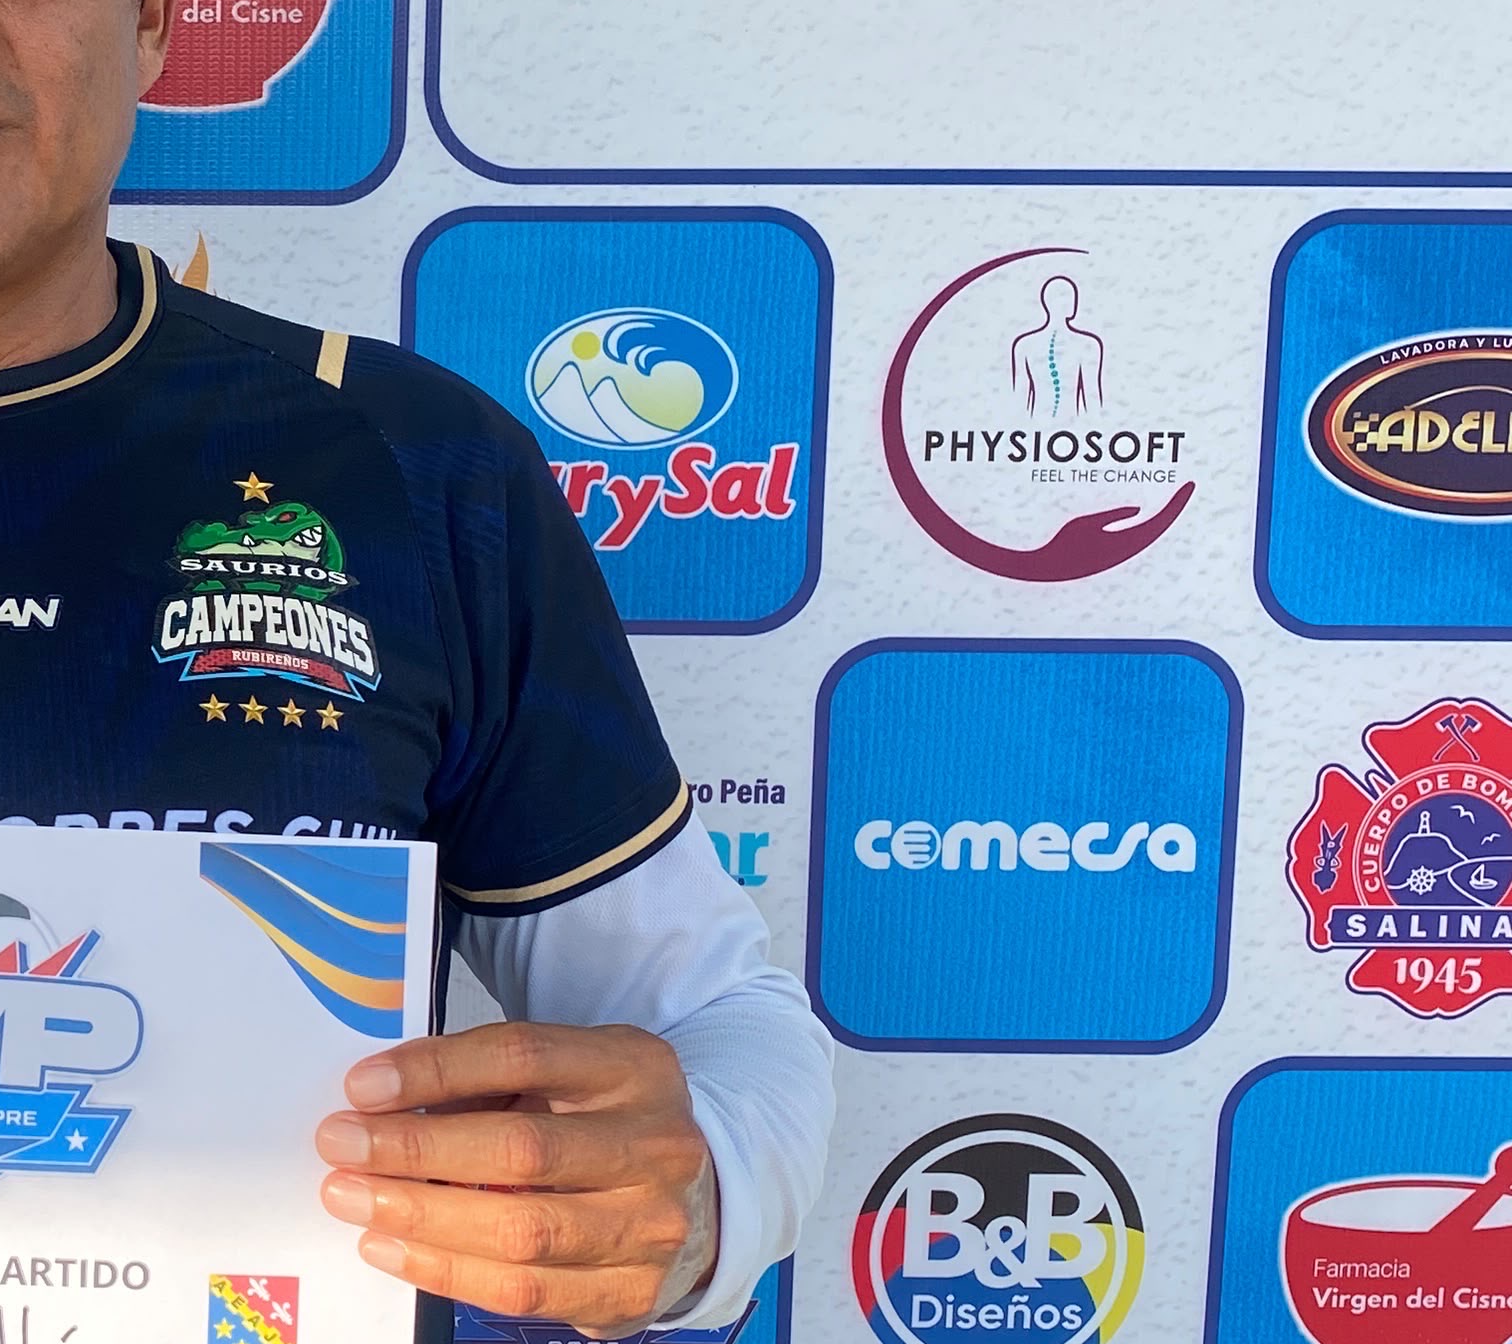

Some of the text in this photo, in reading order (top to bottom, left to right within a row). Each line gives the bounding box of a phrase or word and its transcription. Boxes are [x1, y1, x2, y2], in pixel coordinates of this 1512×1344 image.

[230, 0, 305, 24] Cisne
[1380, 338, 1468, 365] LAVADORA
[1476, 338, 1486, 347] Y
[923, 430, 1186, 463] PHYSIOSOFT
[1031, 469, 1176, 484] FEEL THE CHANGE
[180, 559, 348, 585] SAURIOS
[160, 594, 375, 676] CAMPEONES
[721, 779, 786, 804] Peña
[1362, 773, 1451, 892] CUERPO DE
[1346, 915, 1512, 939] SALINA
[1393, 957, 1483, 994] 1945
[902, 1172, 1108, 1289] B&B
[1313, 1258, 1410, 1278] Farmacia
[910, 1294, 1082, 1332] Diseños
[1312, 1287, 1397, 1314] Virgen
[1406, 1287, 1445, 1309] del
